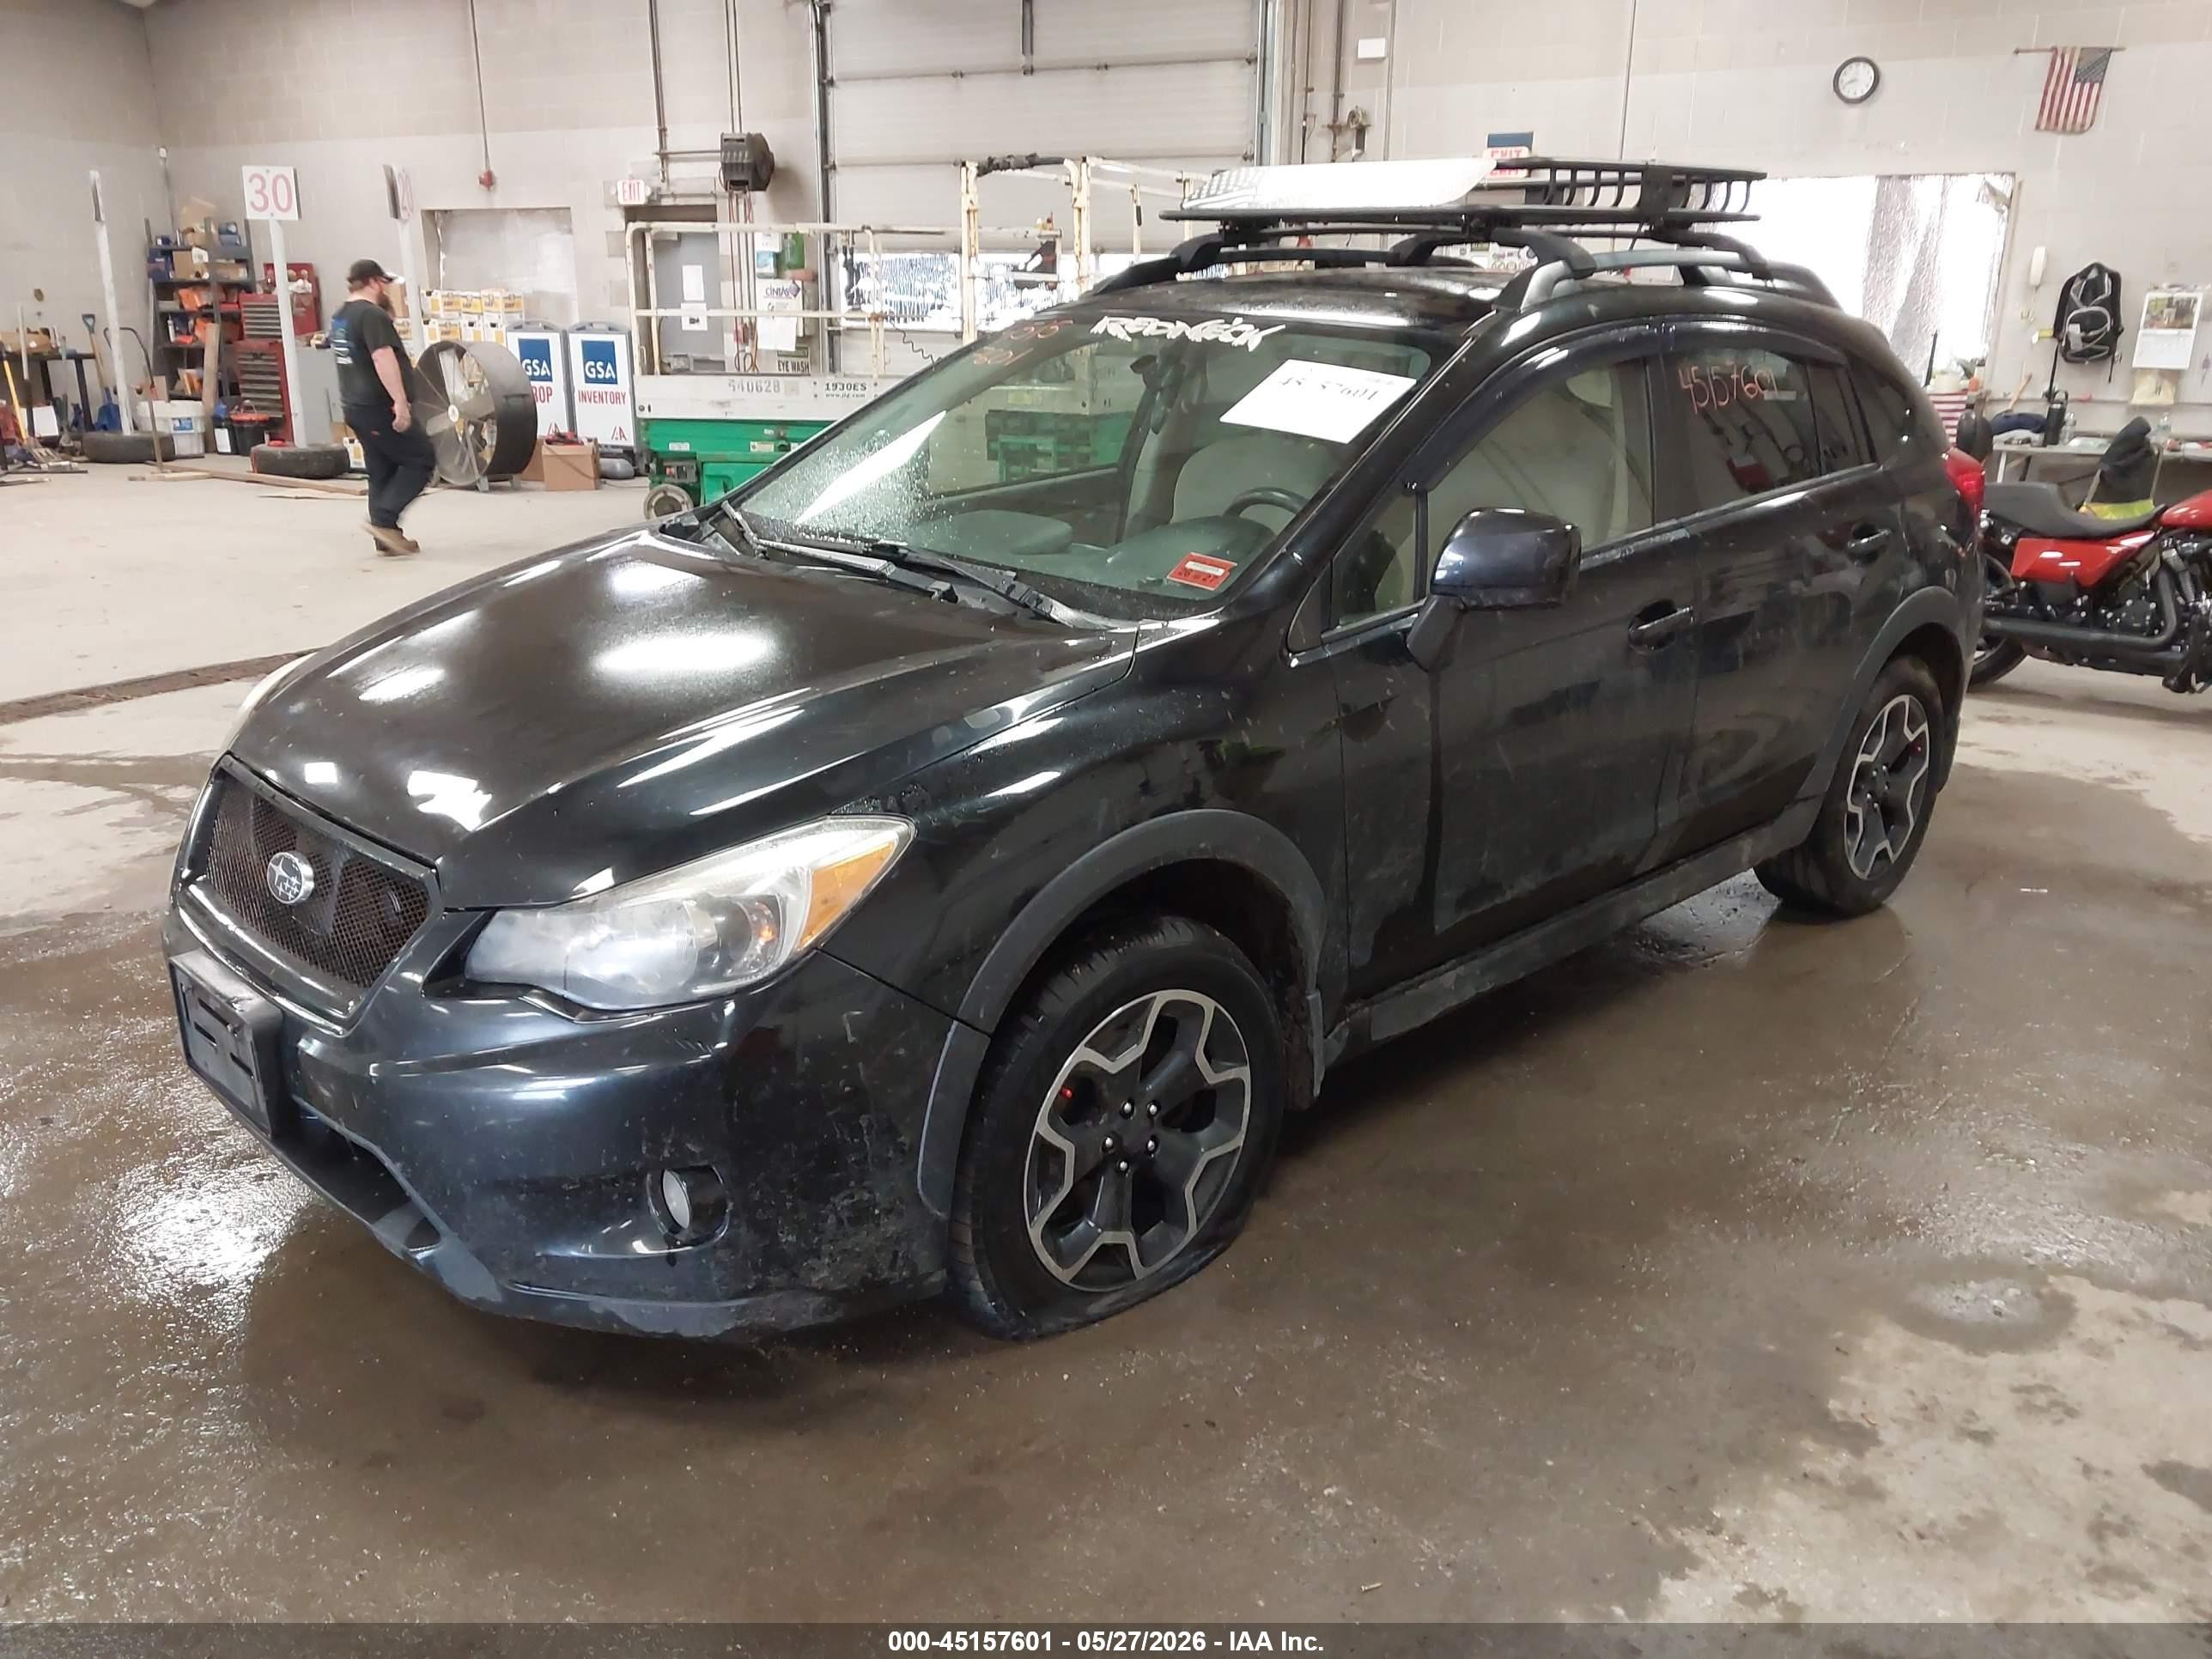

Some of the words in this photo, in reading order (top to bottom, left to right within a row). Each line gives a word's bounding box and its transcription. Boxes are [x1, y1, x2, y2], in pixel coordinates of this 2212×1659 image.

[249, 173, 292, 212] 30
[623, 181, 641, 202] EXIT
[586, 361, 616, 379] GSA
[777, 359, 789, 372] EYE
[791, 360, 809, 373] WASH
[531, 386, 553, 403] ROP
[824, 382, 867, 392] 1930ES
[578, 389, 626, 405] INVENTORY
